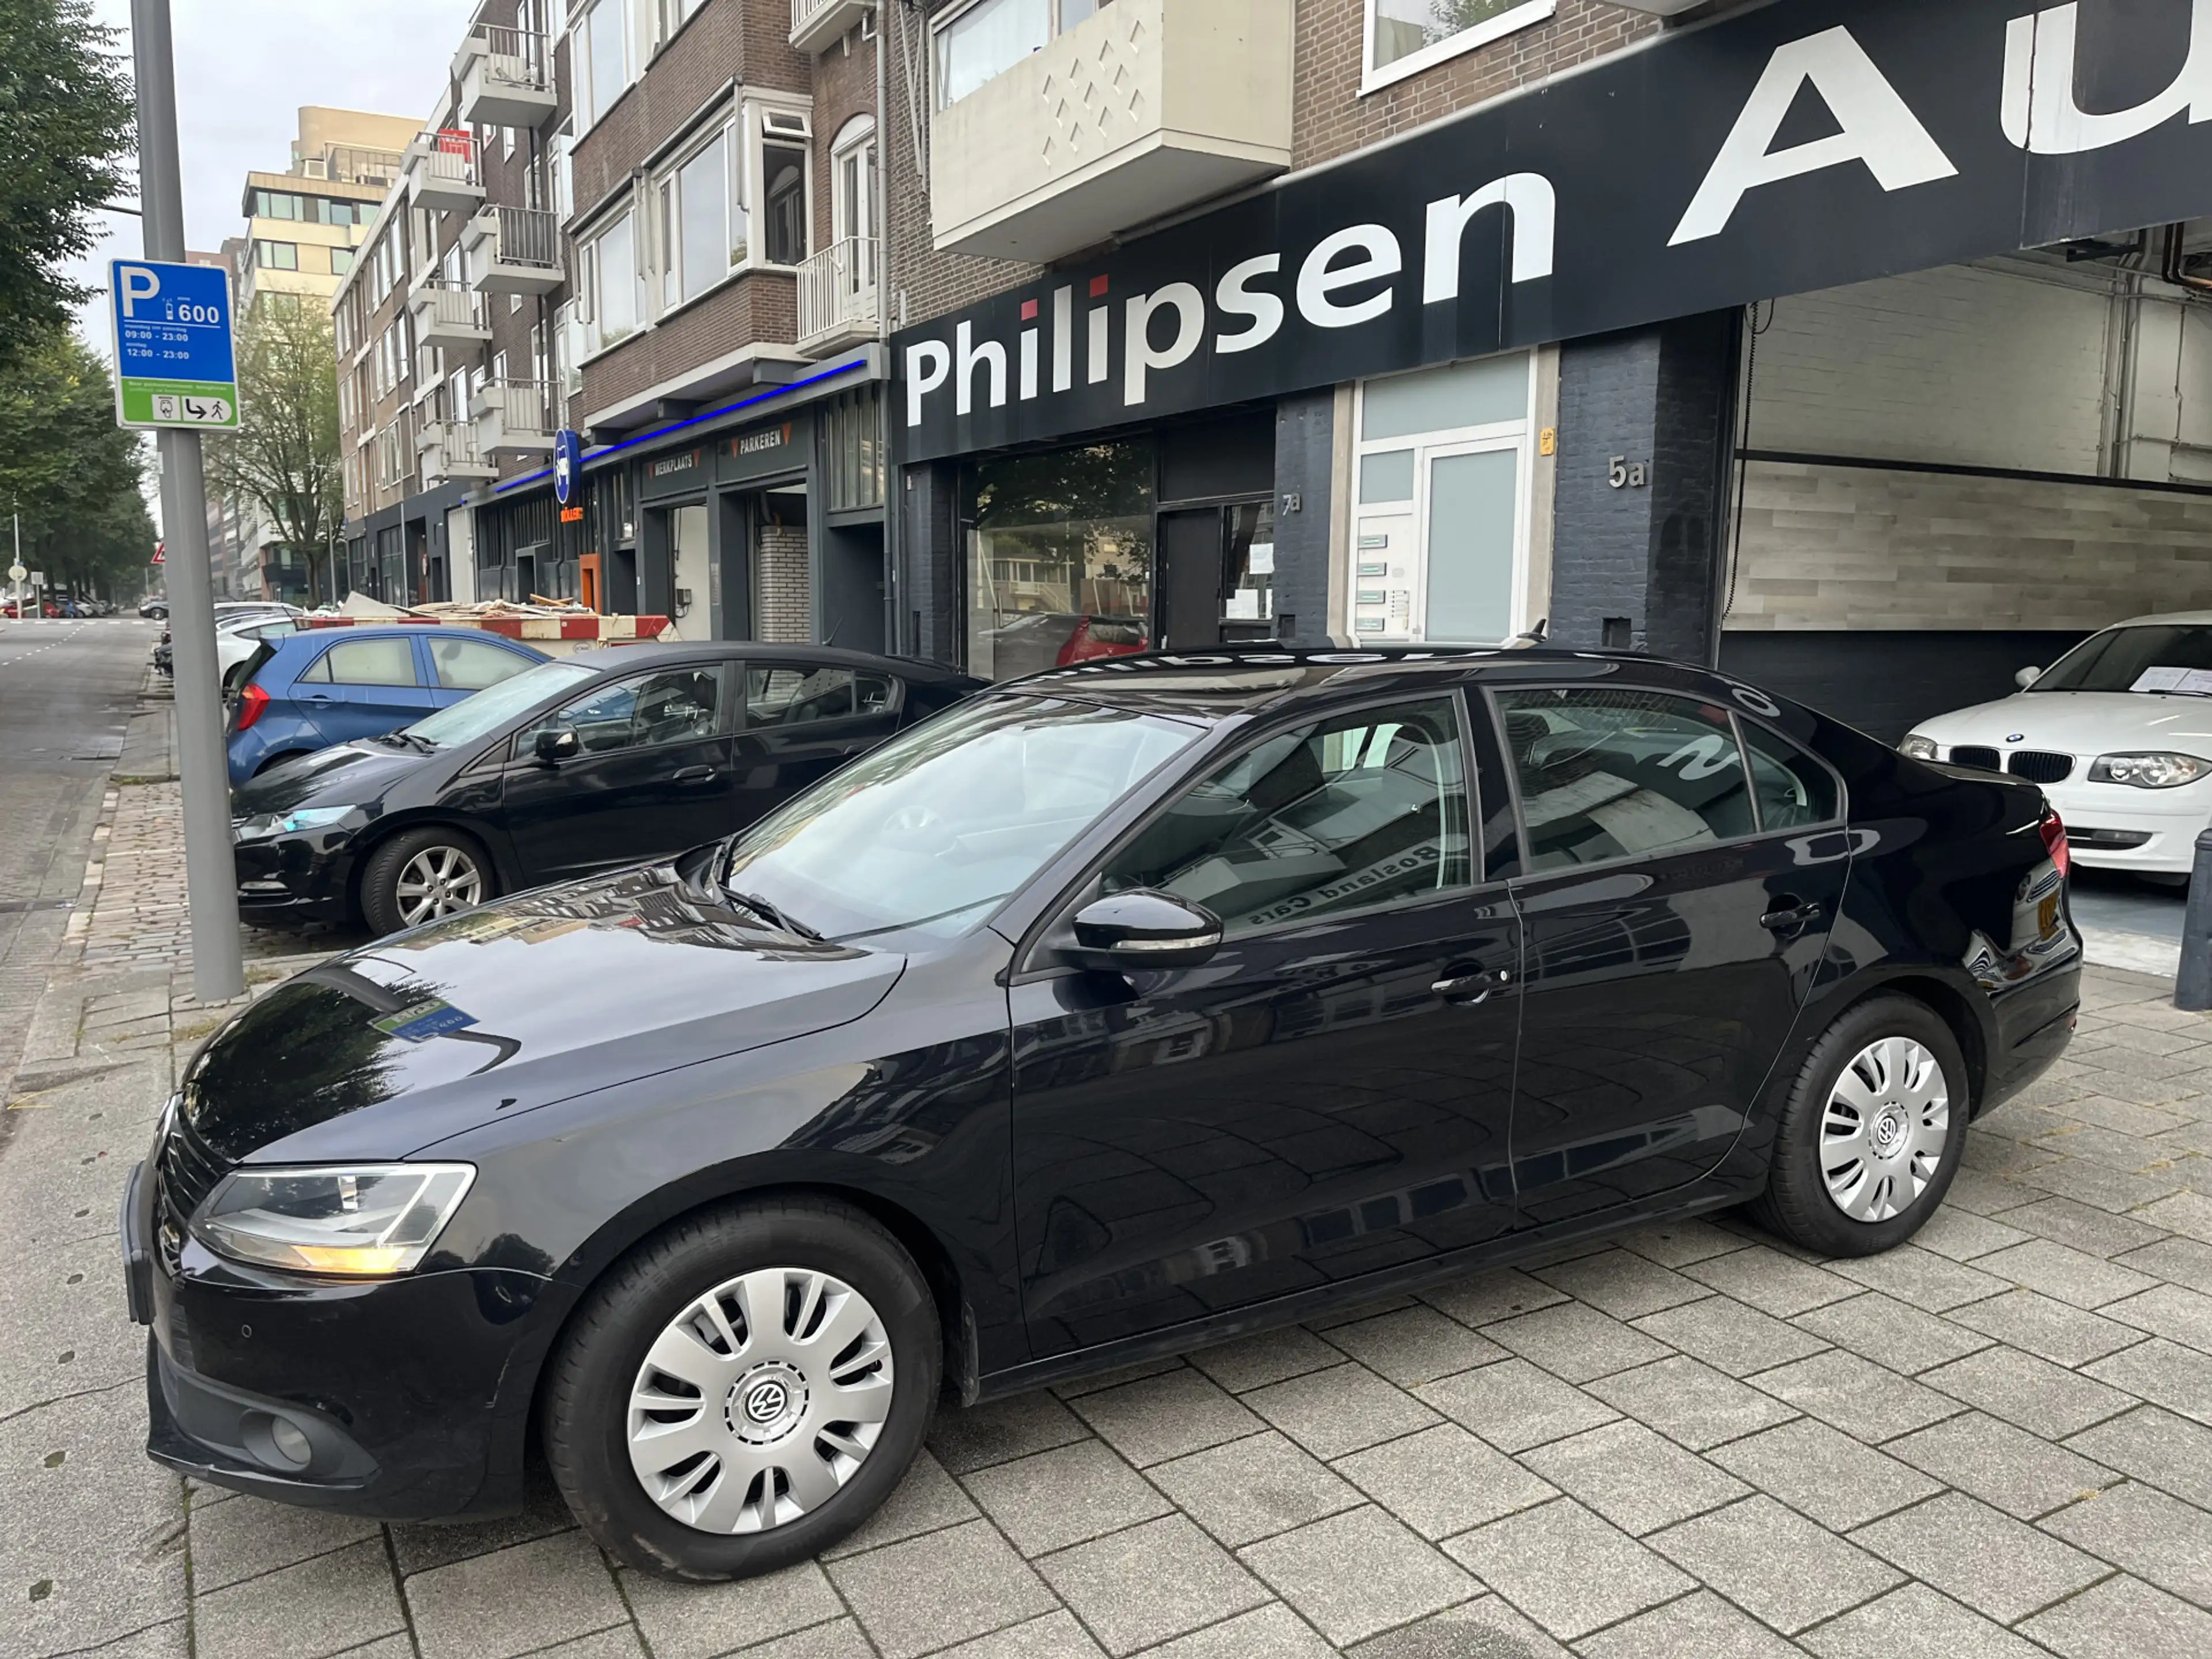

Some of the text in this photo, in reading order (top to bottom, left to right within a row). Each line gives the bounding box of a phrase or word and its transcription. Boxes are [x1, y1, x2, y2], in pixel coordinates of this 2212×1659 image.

[907, 0, 2212, 427] Philipsen Au
[120, 266, 160, 318] P
[179, 304, 219, 324] 600
[125, 329, 152, 340] 09:00
[162, 332, 188, 342] 23:00
[127, 348, 153, 358] 12:00
[163, 350, 190, 359] 23:00
[740, 430, 781, 455] PARKEREN
[655, 453, 692, 477] WERKPLAATS
[1609, 454, 1644, 488] 5a
[1282, 493, 1301, 516] 7a
